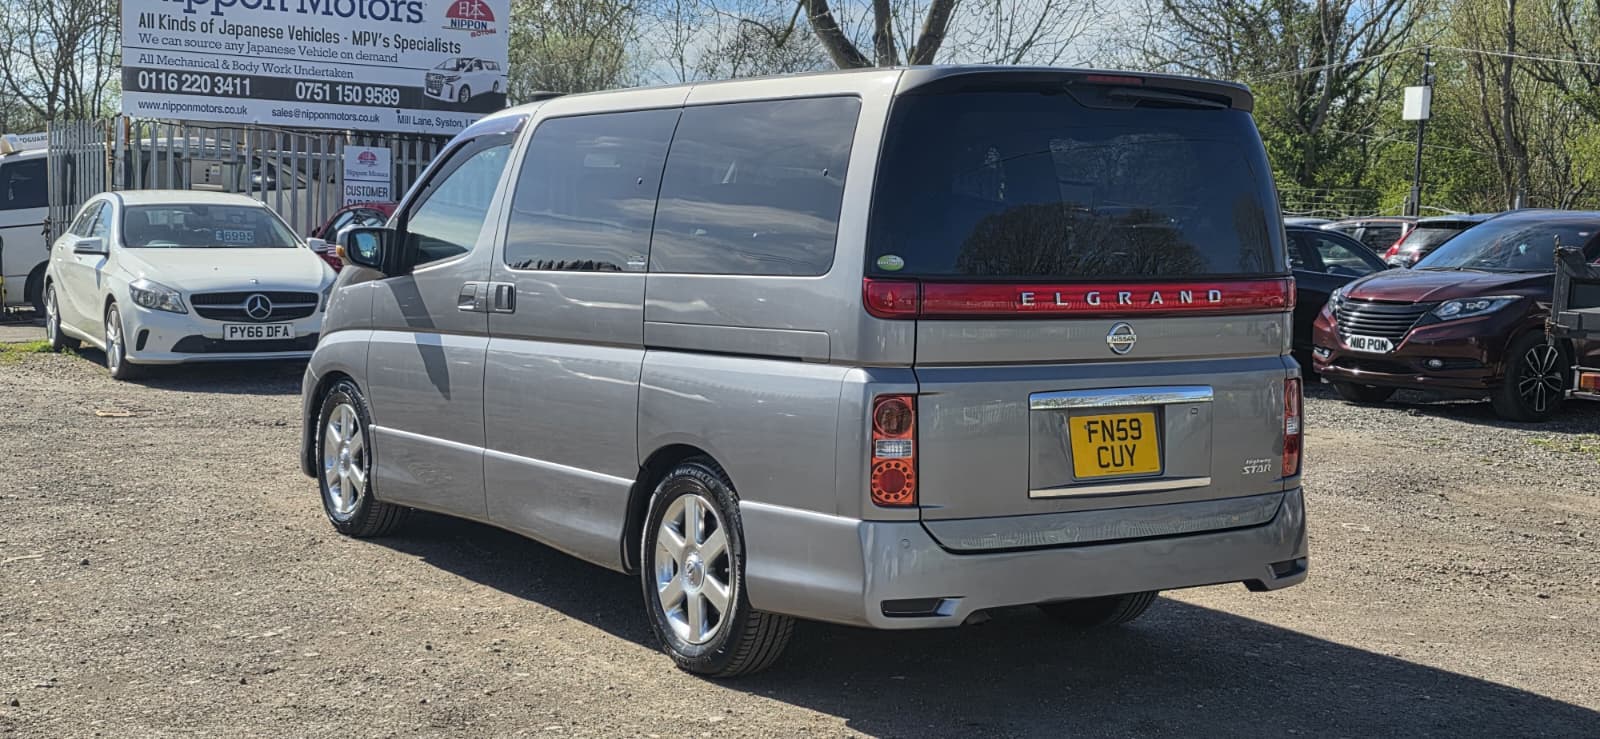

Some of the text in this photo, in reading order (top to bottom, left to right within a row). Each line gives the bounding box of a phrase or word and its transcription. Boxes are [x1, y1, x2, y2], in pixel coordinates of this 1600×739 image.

[450, 19, 488, 30] NIPPON
[139, 12, 155, 29] All
[159, 14, 197, 33] Kinds
[200, 18, 215, 34] of
[219, 20, 284, 39] Japanese
[288, 25, 340, 44] Vehicles
[352, 30, 390, 49] MPV's
[393, 34, 462, 54] Specialists
[138, 33, 398, 63] We can source any Japanese Vehicle on demand
[138, 53, 354, 79] All Mechanical & Body Work Undertaken
[138, 70, 251, 96] 0116 220 3411
[295, 81, 401, 106] 0751 150 9589
[138, 101, 248, 115] www.nipponmotors.co.uk
[271, 107, 381, 123] sales@nipponmotors.co.uk
[397, 114, 411, 125] Mill
[412, 115, 434, 127] Lane,
[435, 116, 464, 129] Syston,
[345, 185, 389, 198] CUSTOMER
[1021, 289, 1222, 306] ELGRAND
[229, 325, 290, 339] PY66 DFA
[1109, 335, 1136, 344] NISSAN
[1367, 338, 1388, 351] PON
[1086, 417, 1143, 444] FN59
[1096, 443, 1137, 469] CUY
[1241, 464, 1272, 475] STAR
